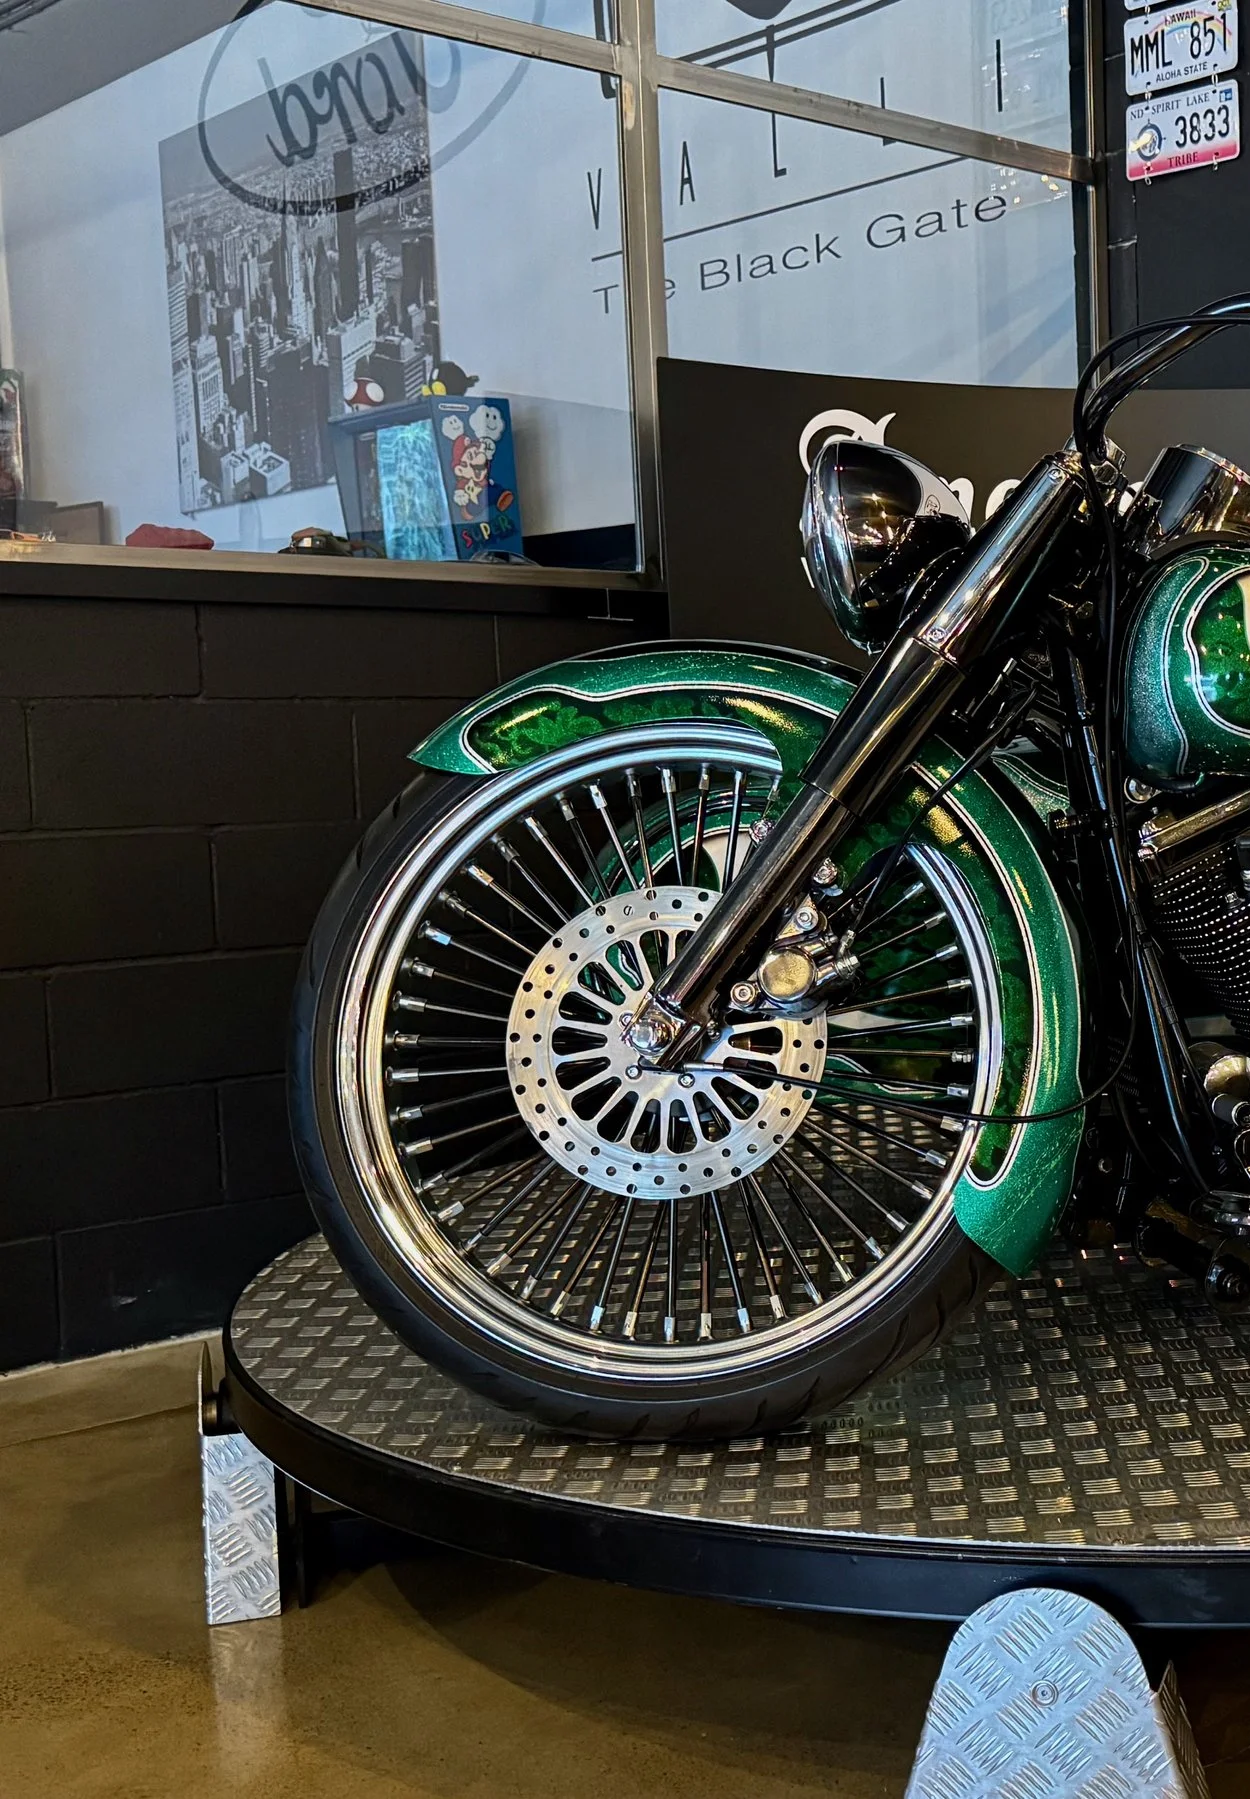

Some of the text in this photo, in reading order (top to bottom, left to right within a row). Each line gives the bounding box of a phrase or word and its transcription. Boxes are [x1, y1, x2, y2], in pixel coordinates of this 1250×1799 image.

[1130, 12, 1228, 76] MML 851
[1155, 62, 1208, 83] ALOHA STATE
[1130, 91, 1210, 121] ND SPIRIT LAKE
[1174, 104, 1230, 149] 3833
[1167, 152, 1199, 168] TRIBE
[592, 194, 1008, 314] Te Black Gate
